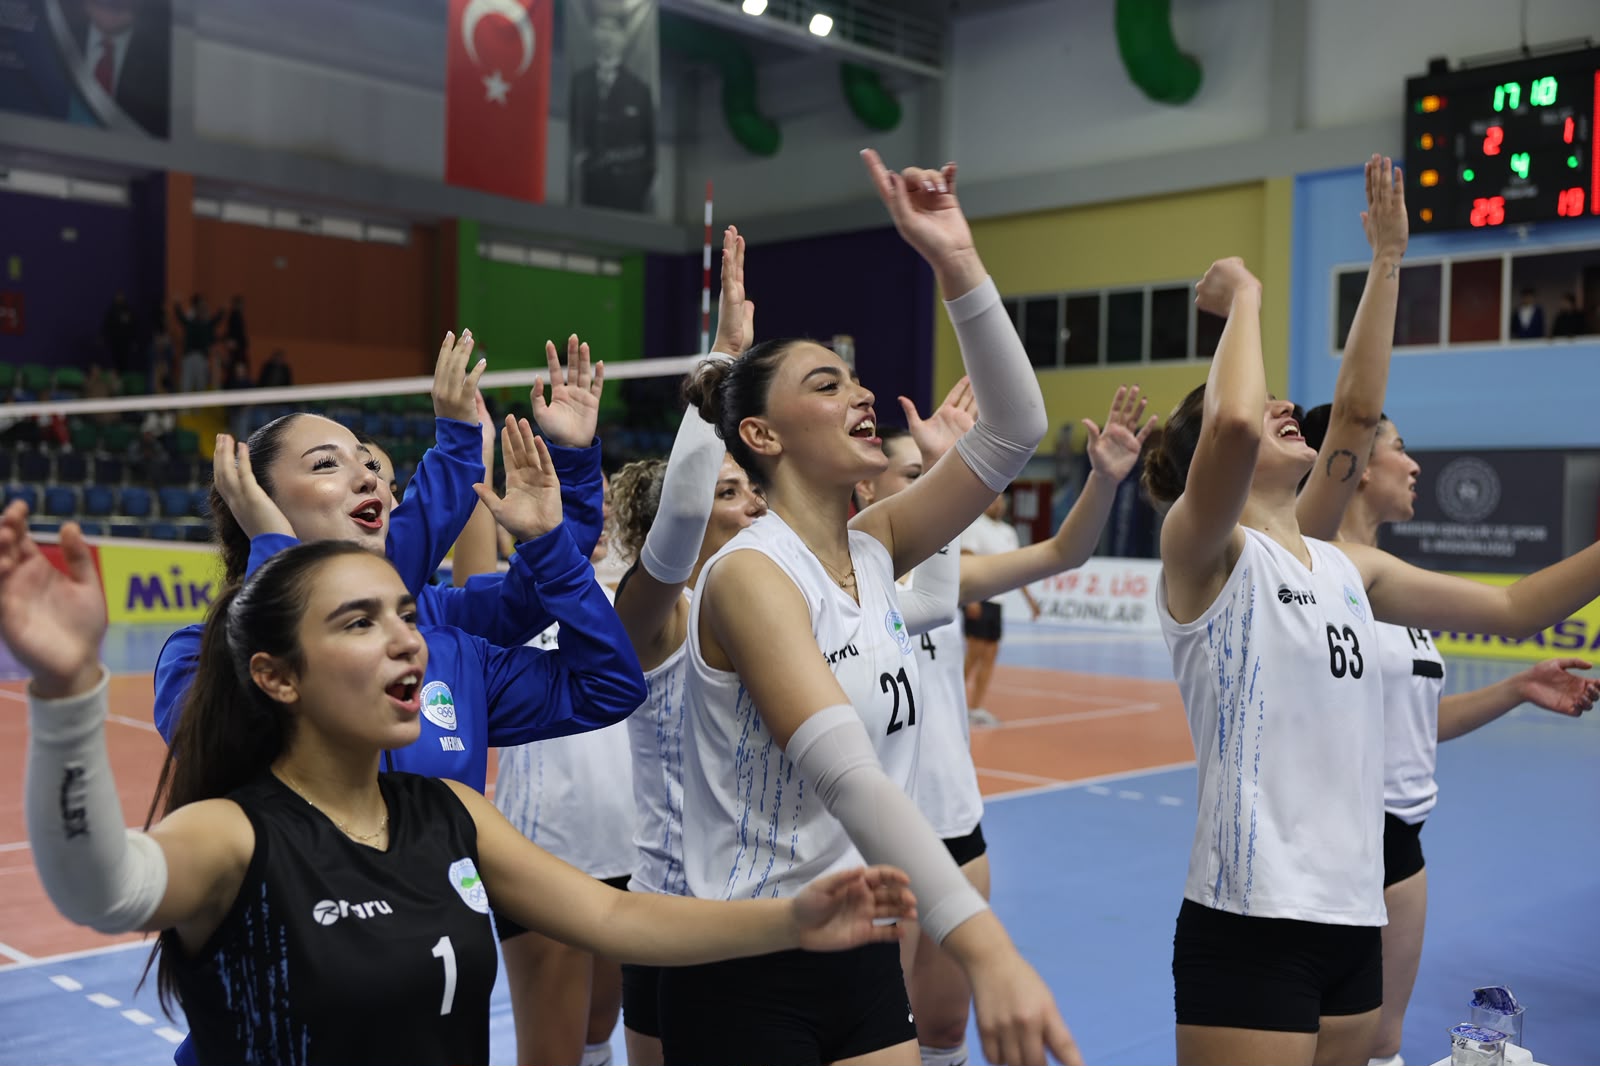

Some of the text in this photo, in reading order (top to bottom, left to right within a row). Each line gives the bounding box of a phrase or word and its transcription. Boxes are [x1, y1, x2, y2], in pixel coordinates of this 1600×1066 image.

[1493, 76, 1558, 112] 17 10
[1483, 125, 1504, 156] 2
[1563, 116, 1575, 144] 1
[1510, 152, 1530, 178] 4
[1326, 622, 1364, 679] 63
[880, 667, 915, 736] 21
[431, 935, 457, 1015] 1
